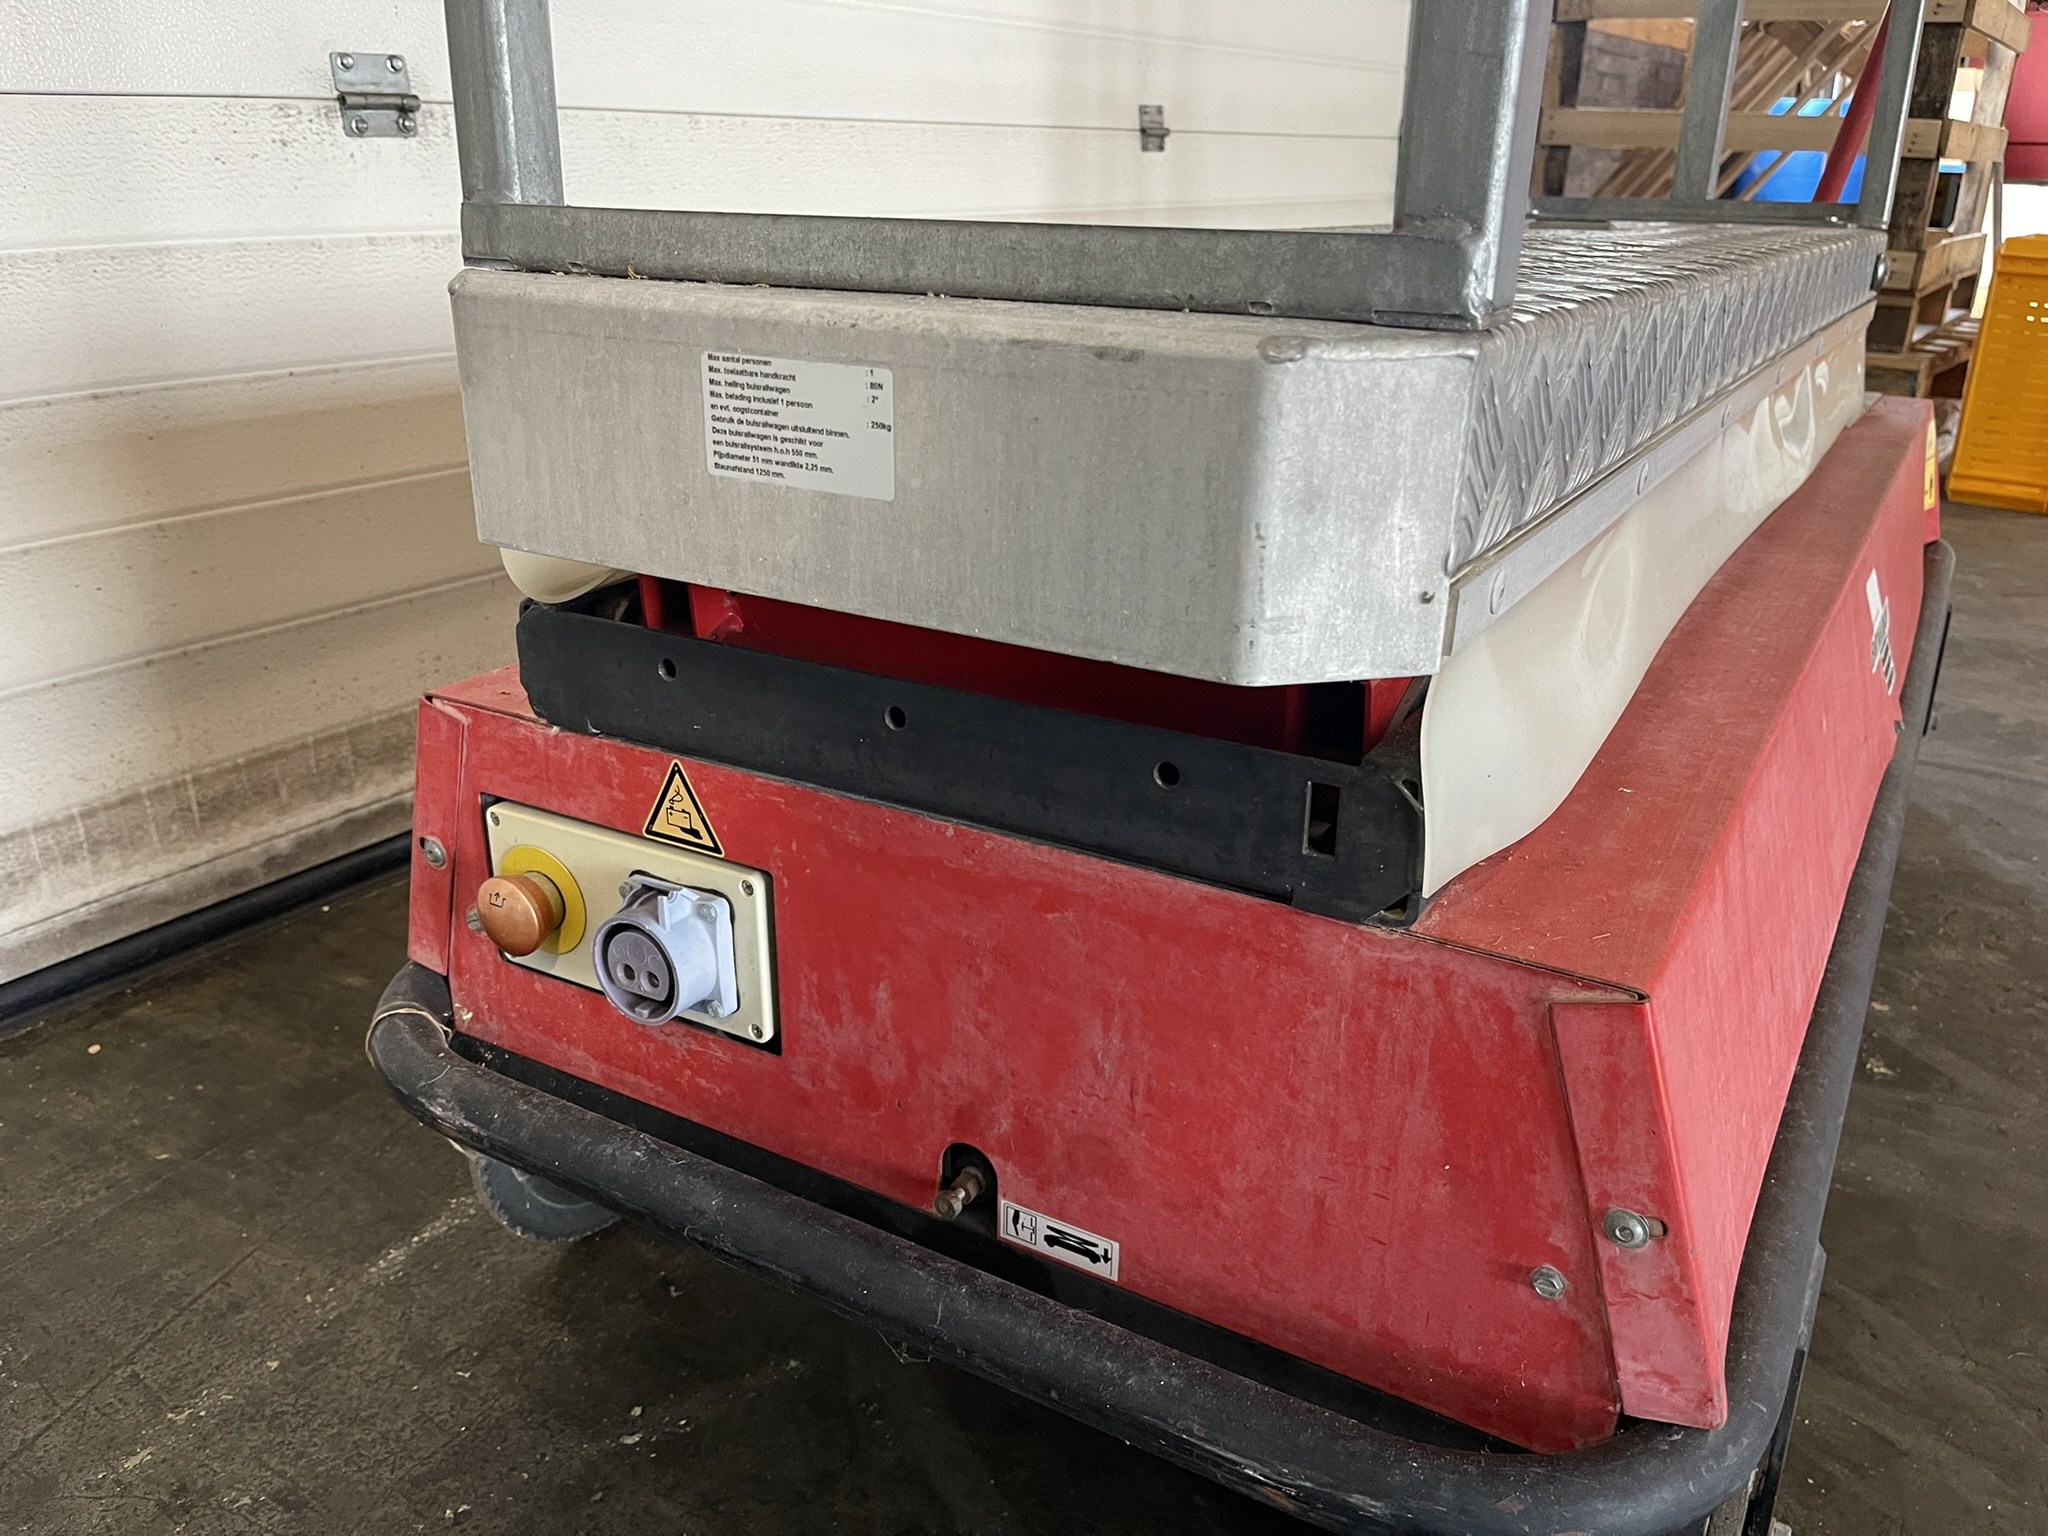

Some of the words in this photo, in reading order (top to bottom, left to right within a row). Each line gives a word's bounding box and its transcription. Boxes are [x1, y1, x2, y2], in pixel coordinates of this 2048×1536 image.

[742, 358, 772, 366] personen
[708, 365, 722, 374] Max.
[724, 367, 758, 378] toelaatbare
[760, 370, 796, 381] handkracht
[869, 382, 884, 391] 80N
[709, 378, 723, 386] Max.
[724, 380, 745, 390] helling
[746, 382, 791, 395] buisrailwagen
[710, 390, 724, 399] Max.
[725, 392, 752, 403] belading
[753, 395, 779, 405] inclusief
[786, 400, 813, 409] persoon
[711, 414, 735, 424] Gebruik
[746, 419, 789, 431] buisrailwagen
[791, 425, 824, 436] uitsluitend
[825, 429, 850, 439] binnen.
[732, 406, 779, 417] oogstcontainer
[871, 421, 892, 432] 250kg
[712, 426, 727, 435] Deze
[728, 429, 772, 441] buisrailwagen
[780, 437, 806, 446] geschikt
[725, 440, 772, 453] buisrailsysteem
[774, 446, 790, 455] h.o.h
[792, 448, 803, 457] 550
[714, 450, 751, 462] Pijpdiameter
[805, 462, 818, 472] 2,25
[714, 462, 754, 474] Steunafstand
[756, 468, 770, 477] 1250
